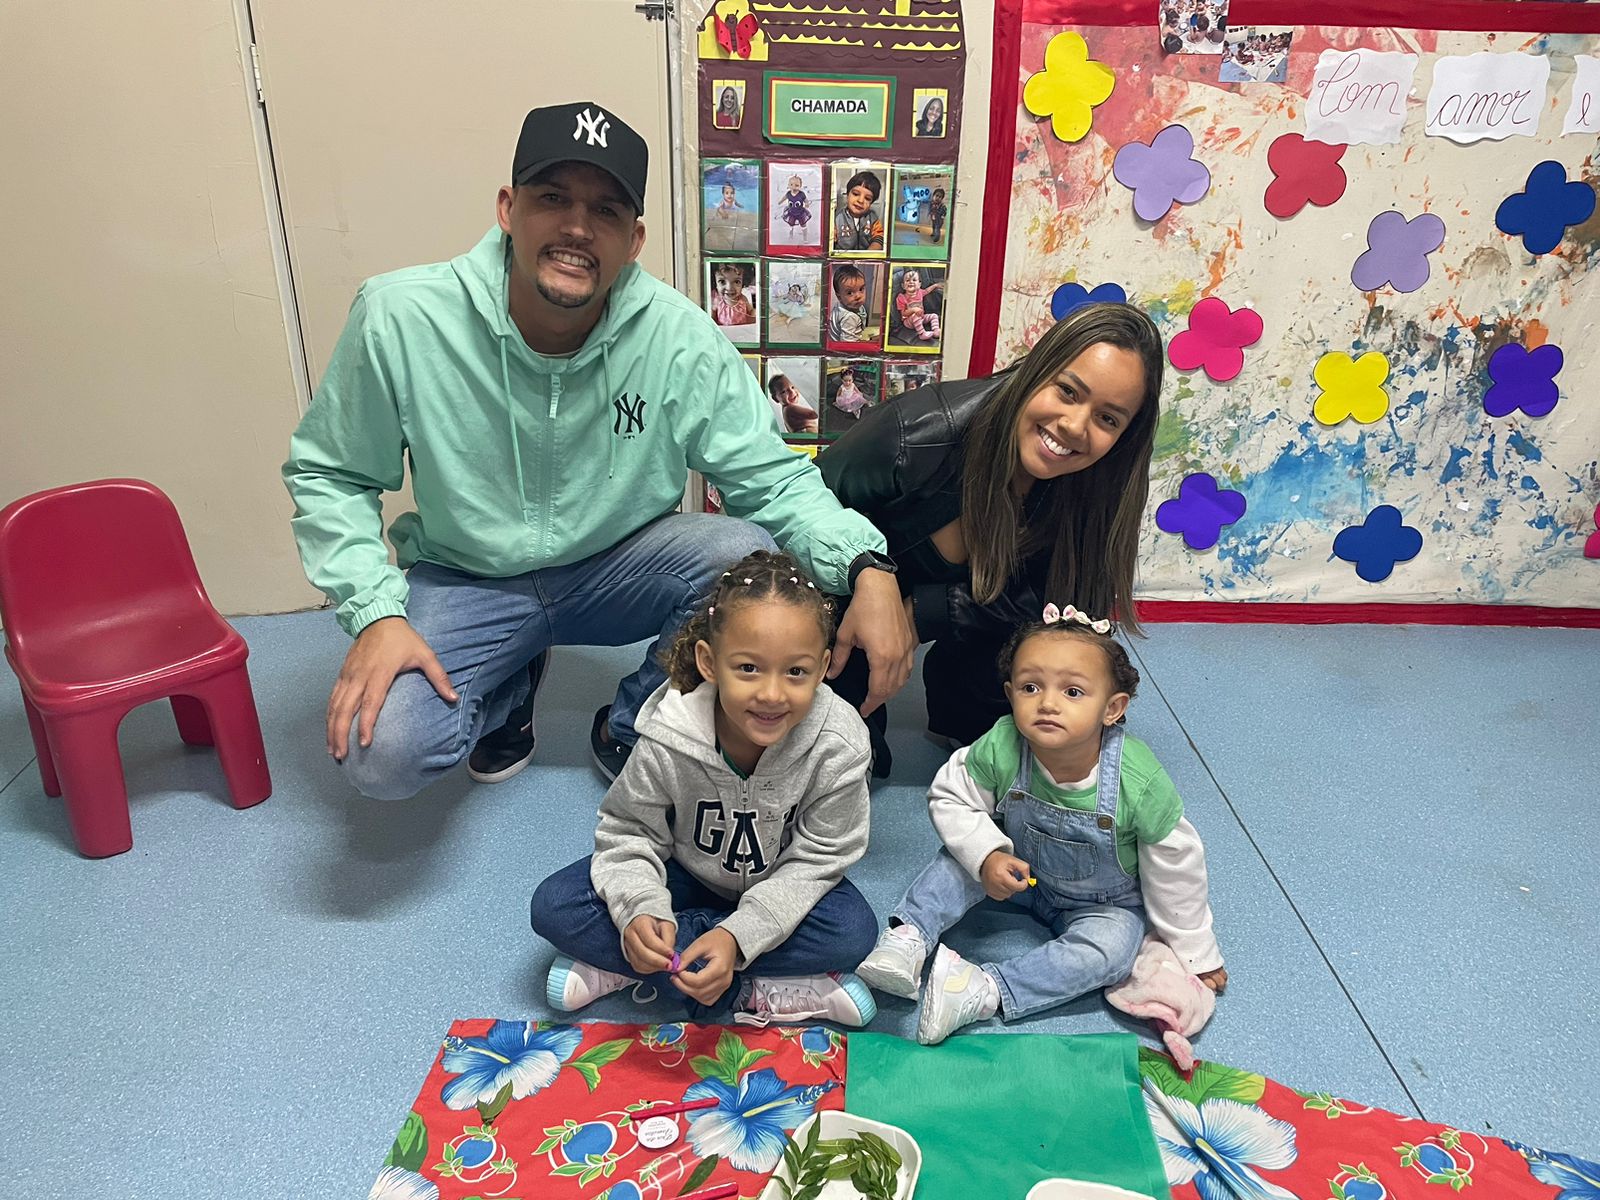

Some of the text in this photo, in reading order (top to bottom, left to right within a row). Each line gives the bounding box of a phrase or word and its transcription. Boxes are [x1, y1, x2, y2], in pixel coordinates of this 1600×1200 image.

[791, 99, 867, 113] CHAMADA
[1427, 90, 1531, 127] amor
[573, 108, 611, 148] NY
[613, 392, 647, 435] NY
